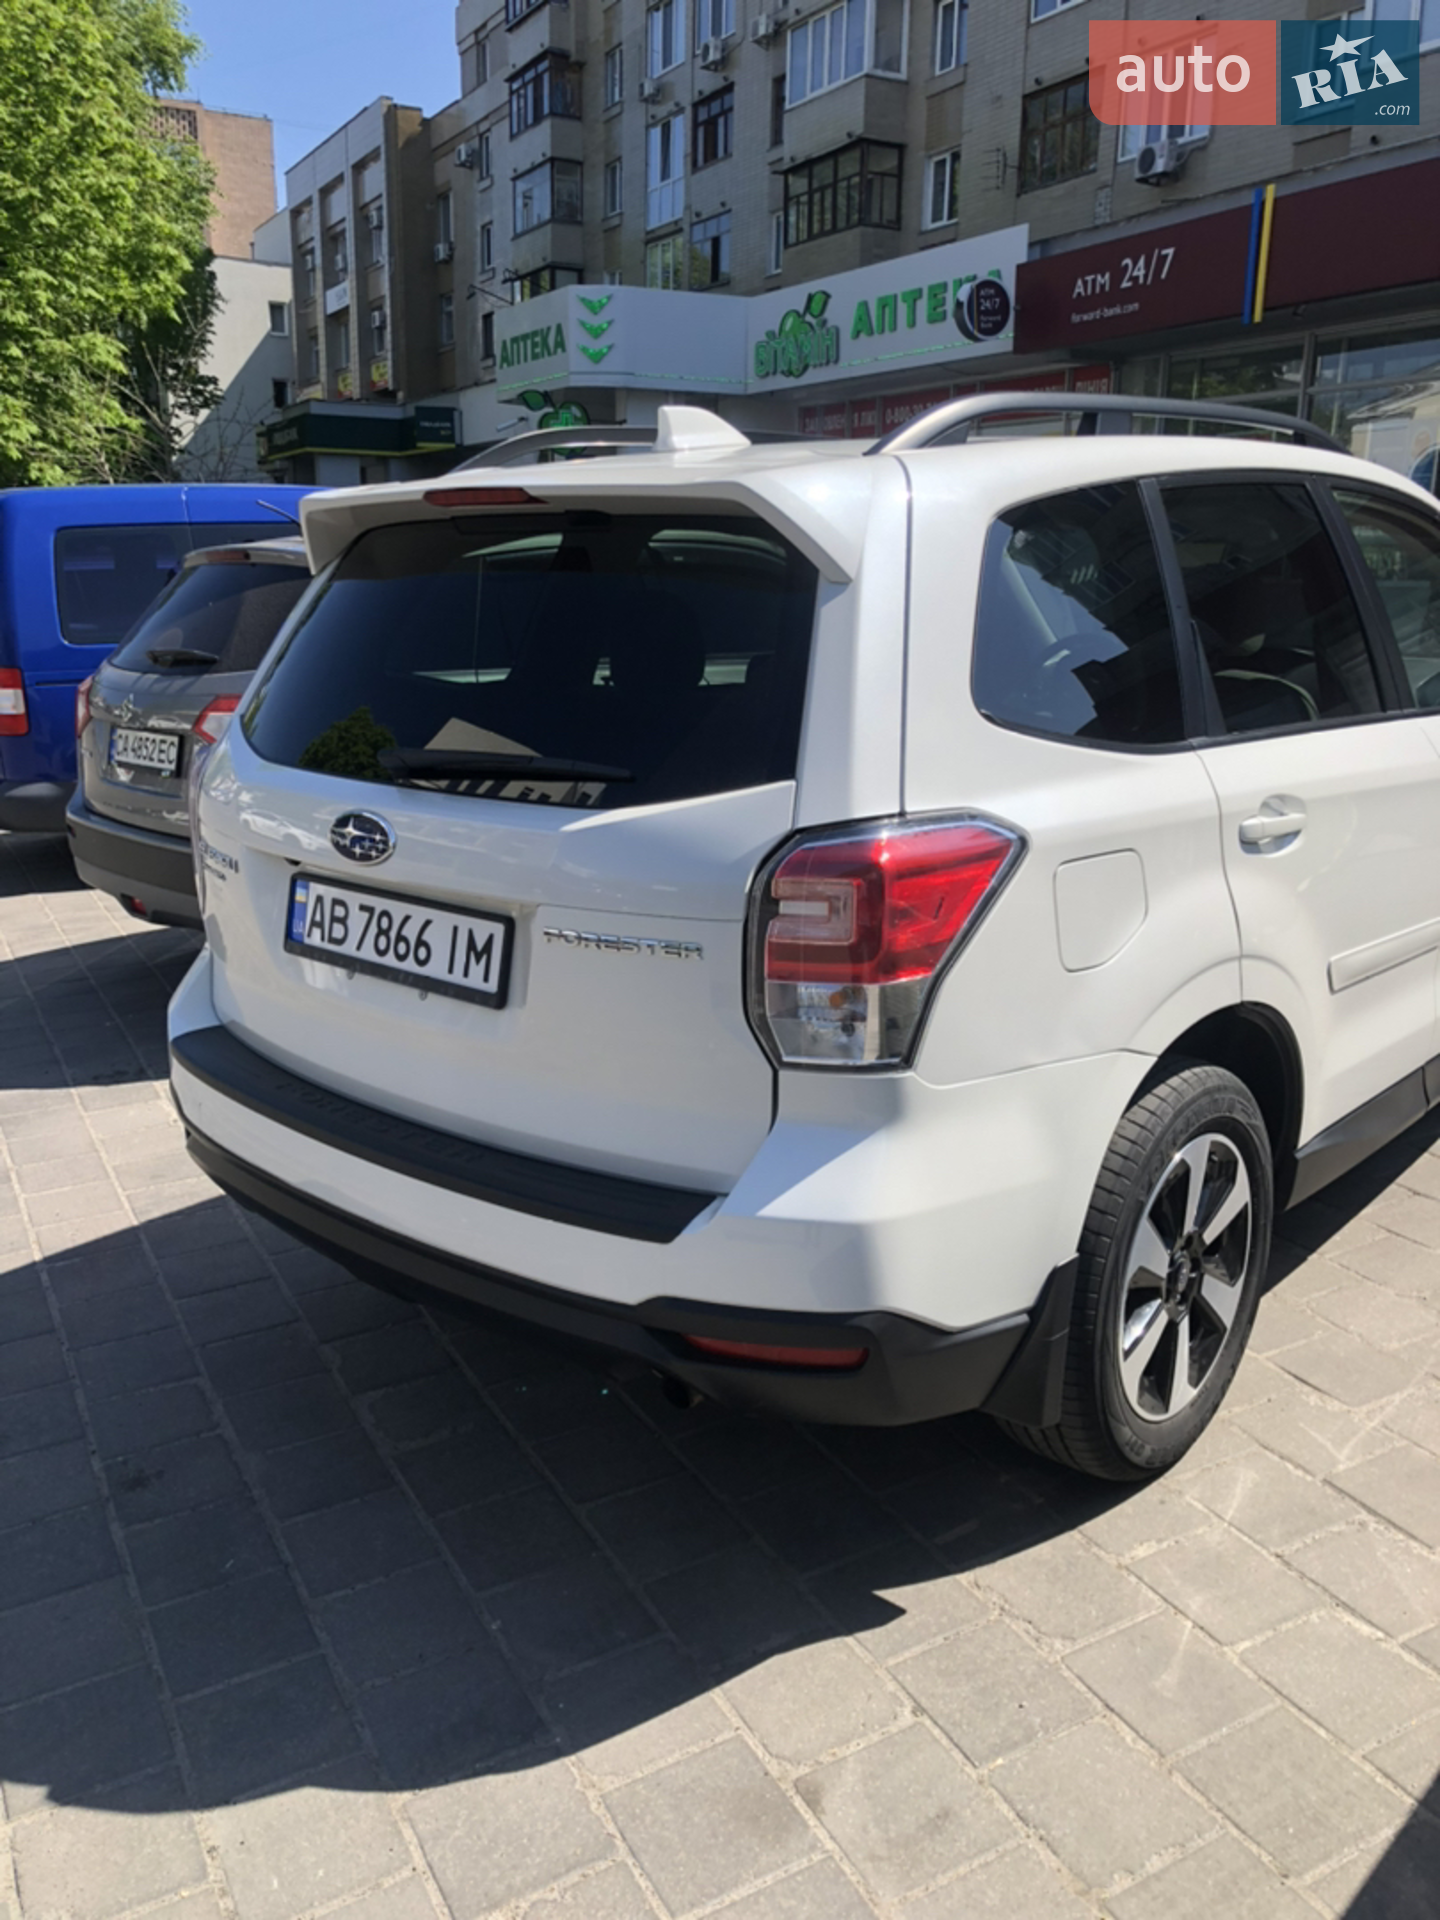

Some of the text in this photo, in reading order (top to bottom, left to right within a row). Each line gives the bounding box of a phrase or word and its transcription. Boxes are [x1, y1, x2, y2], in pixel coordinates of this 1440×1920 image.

[979, 288, 995, 297] ATM
[1072, 246, 1176, 299] ATM 24/7
[850, 269, 1002, 340] АПТЕ
[979, 298, 1000, 310] 24/7
[499, 322, 567, 370] АПТЕКА
[130, 736, 155, 762] 4852
[157, 740, 176, 765] EC
[306, 894, 495, 984] AB 7866 IM
[543, 926, 704, 960] FORESTER
